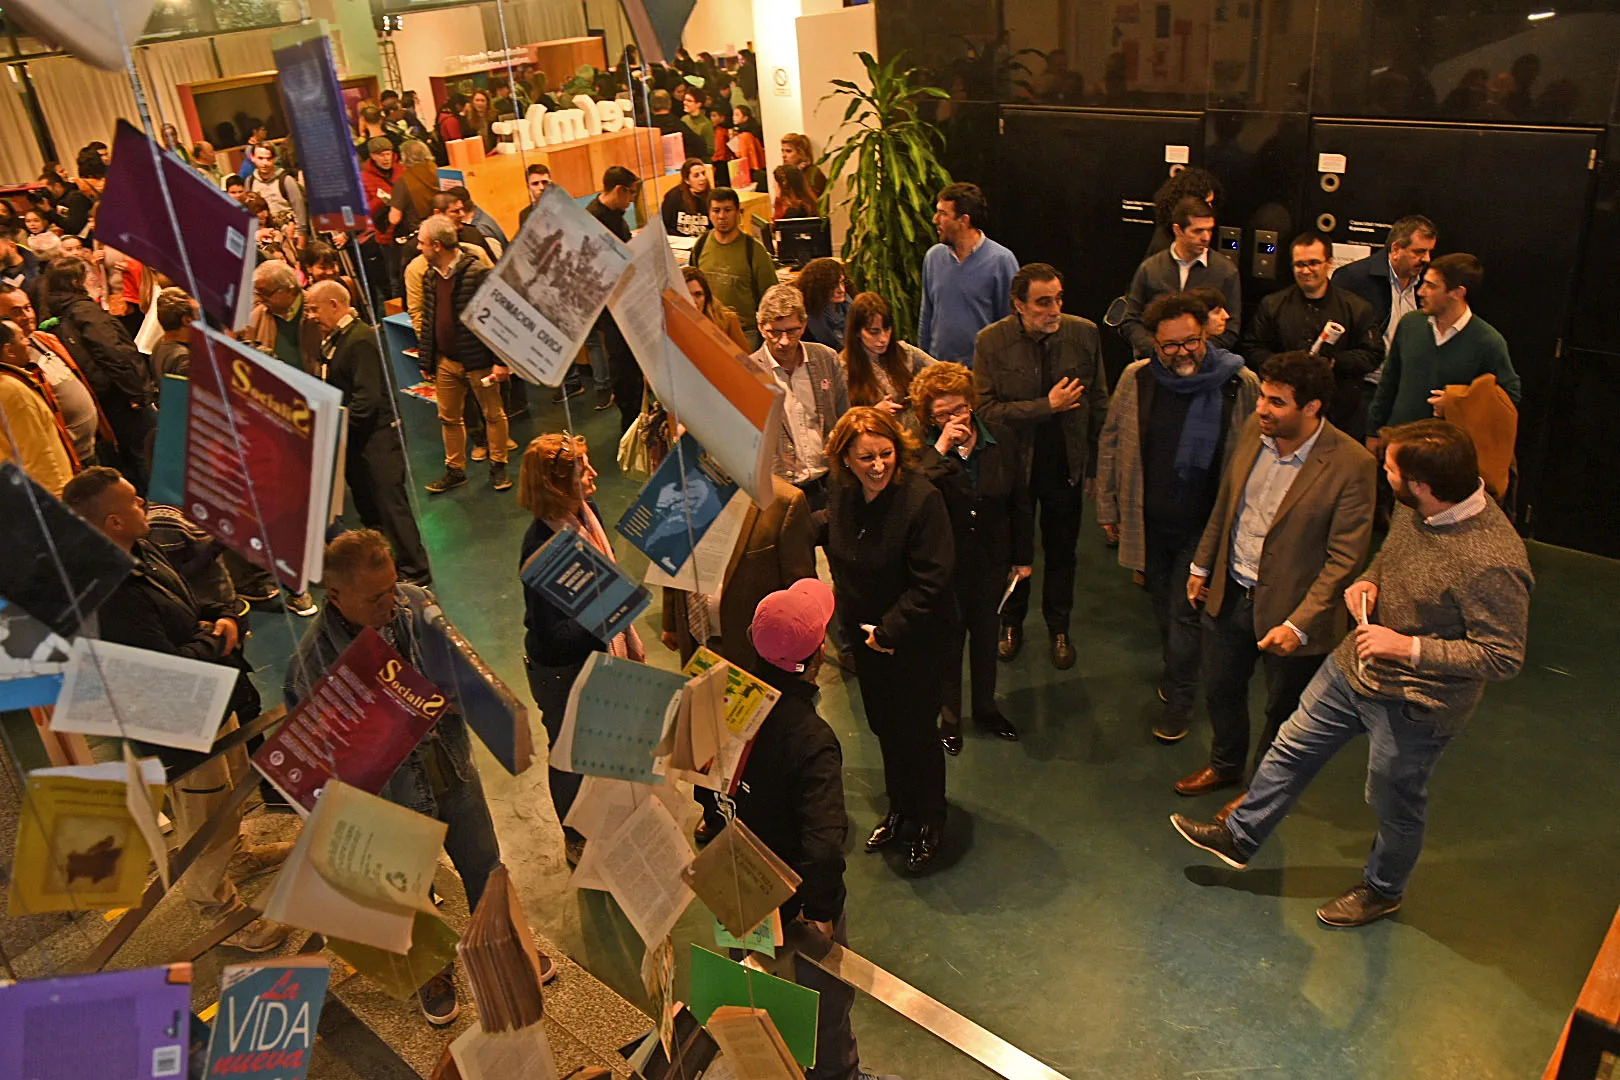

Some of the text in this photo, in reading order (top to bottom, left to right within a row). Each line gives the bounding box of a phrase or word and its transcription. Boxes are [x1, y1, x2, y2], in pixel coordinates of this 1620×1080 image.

[477, 307, 491, 325] 2
[491, 288, 536, 332] FORMACION
[537, 329, 563, 356] CIVICA
[260, 968, 300, 1000] La
[228, 995, 309, 1052] VIDA
[212, 1049, 305, 1075] nueva
